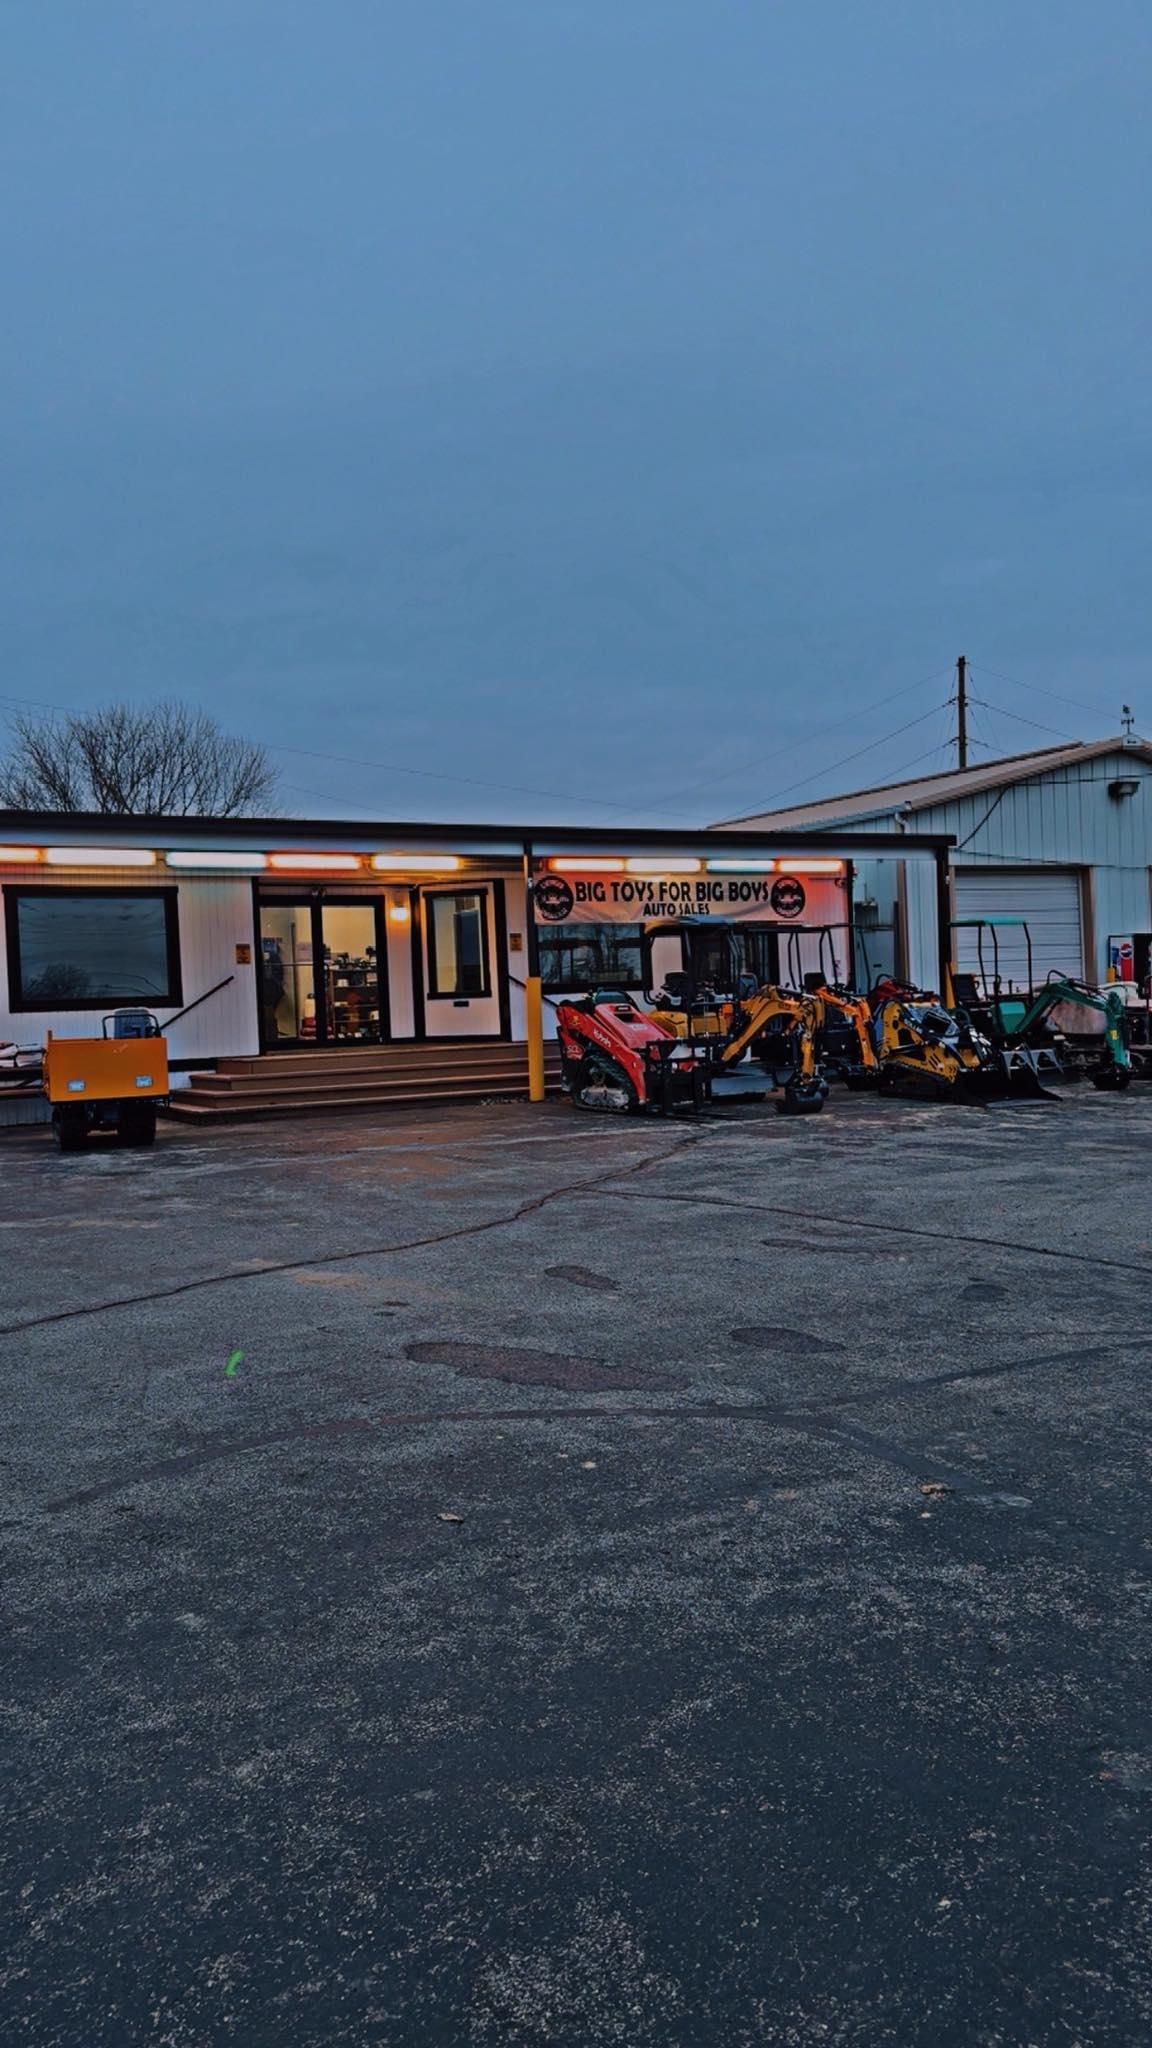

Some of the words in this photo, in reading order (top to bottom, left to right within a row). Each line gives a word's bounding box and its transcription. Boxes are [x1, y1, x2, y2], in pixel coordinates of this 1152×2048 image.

[575, 881, 606, 902] BIG
[612, 881, 654, 902] TOYS
[659, 881, 691, 902] FOR
[696, 881, 724, 902] BIG
[729, 881, 769, 902] BOYS
[643, 903, 676, 917] AUTO
[678, 903, 710, 916] SALES
